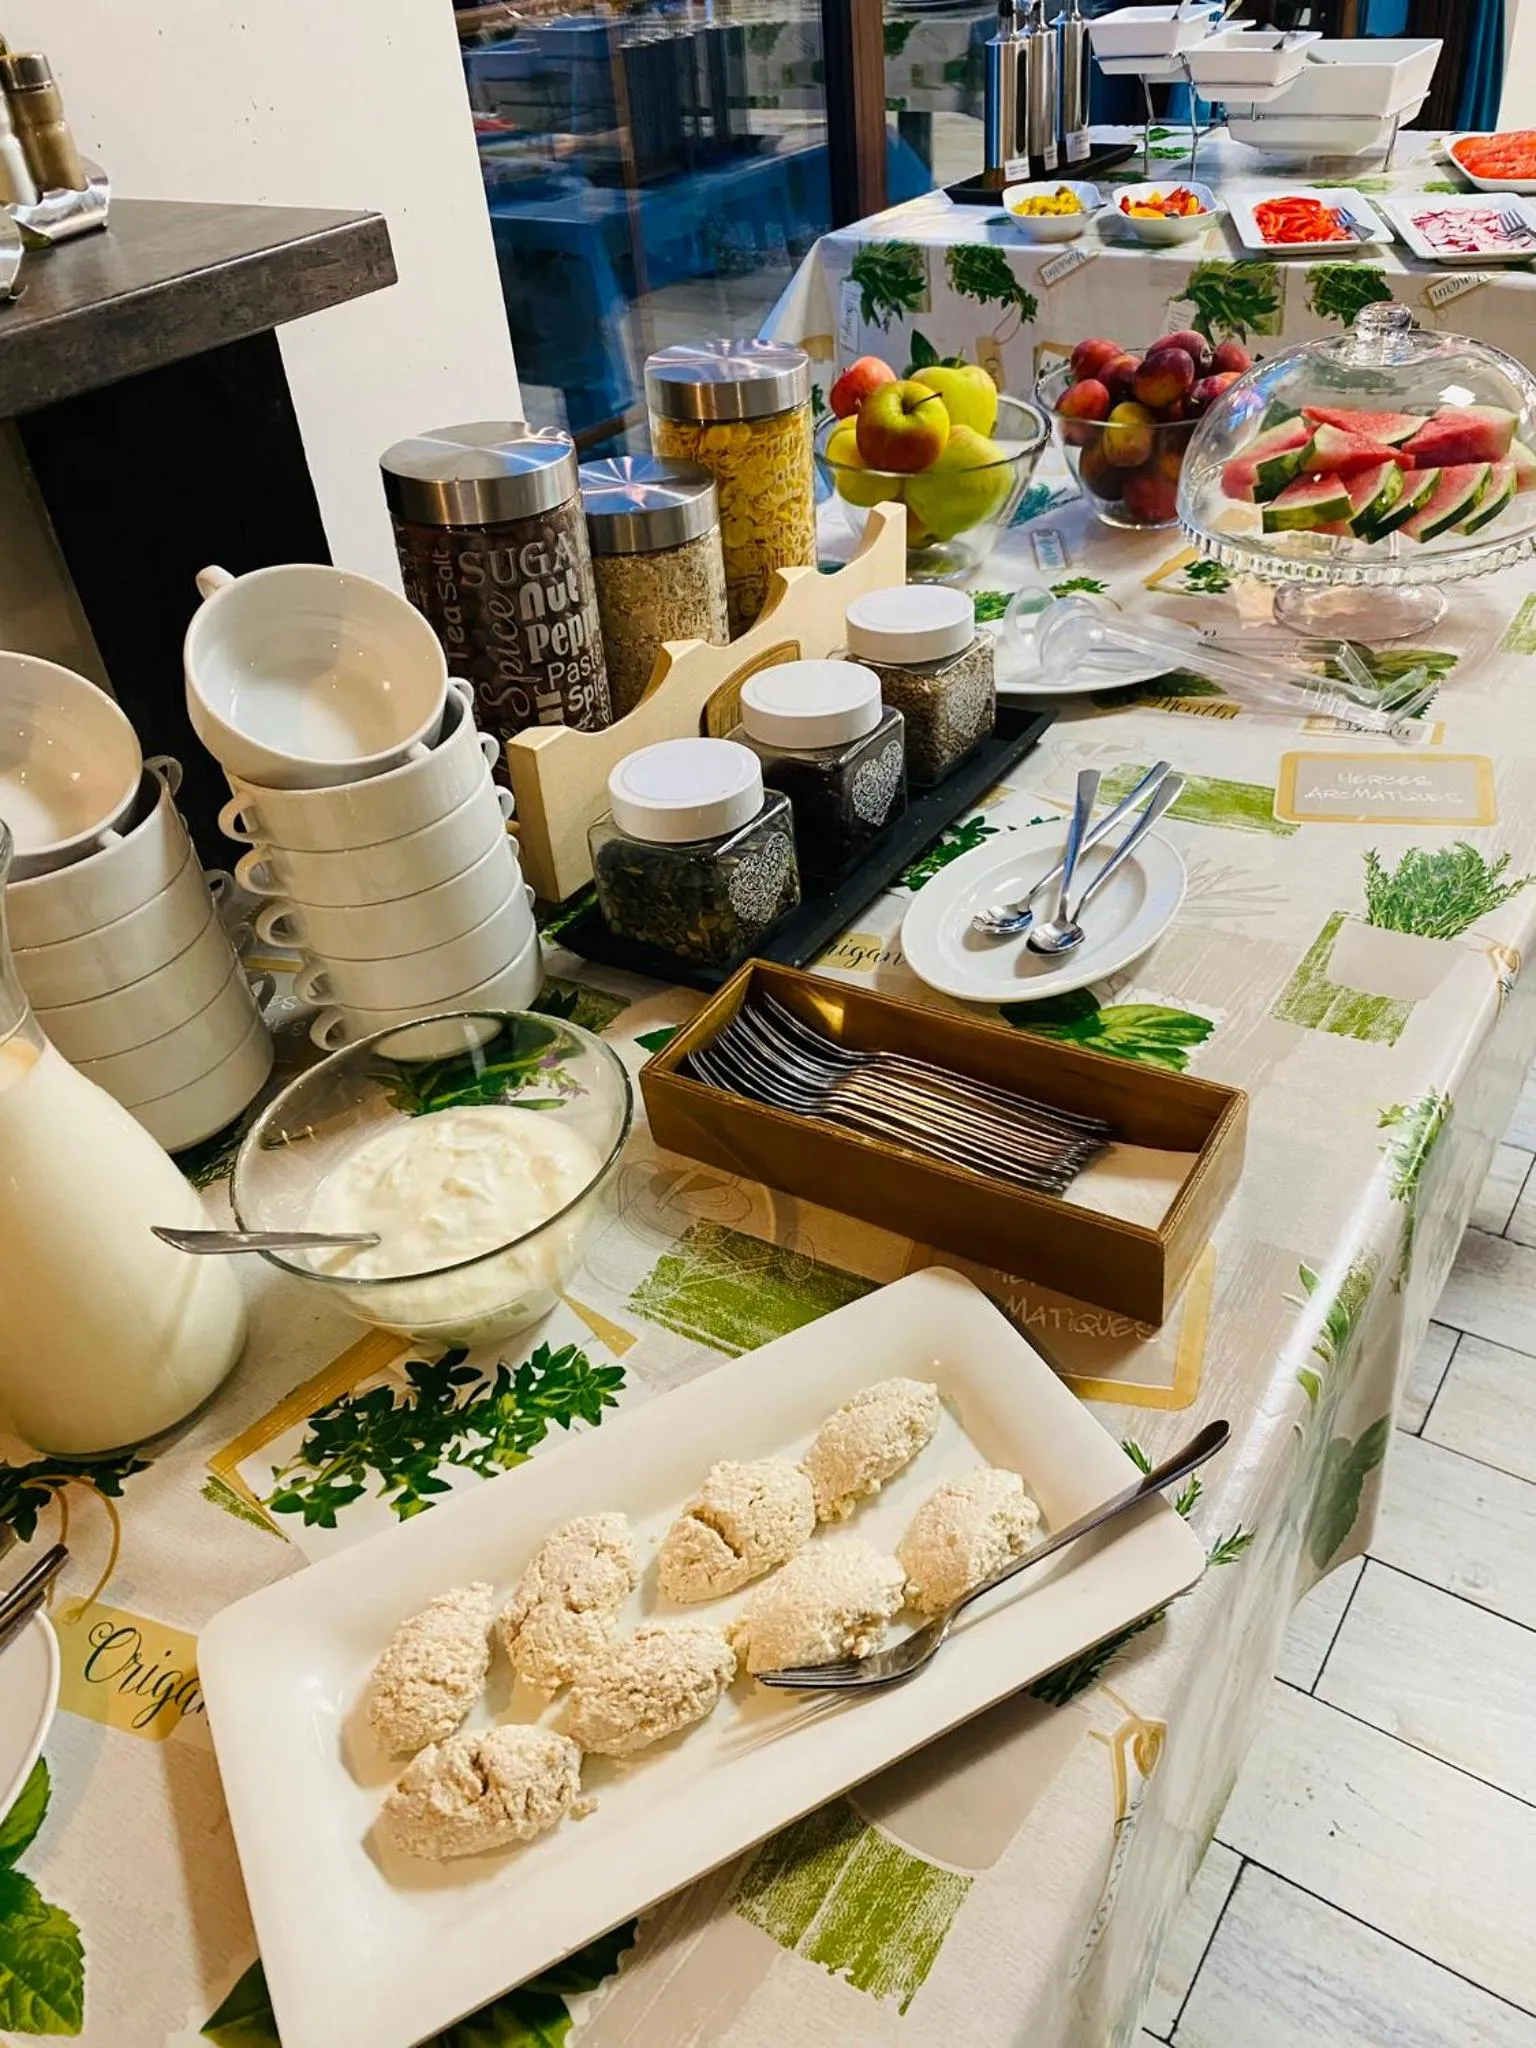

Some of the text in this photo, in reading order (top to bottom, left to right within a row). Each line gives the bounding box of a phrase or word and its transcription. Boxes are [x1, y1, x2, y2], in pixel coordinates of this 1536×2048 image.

[457, 531, 574, 588] SUGA
[825, 937, 905, 969] rigan
[1004, 1294, 1162, 1343] MATIQUES
[83, 1621, 207, 1729] Origa
